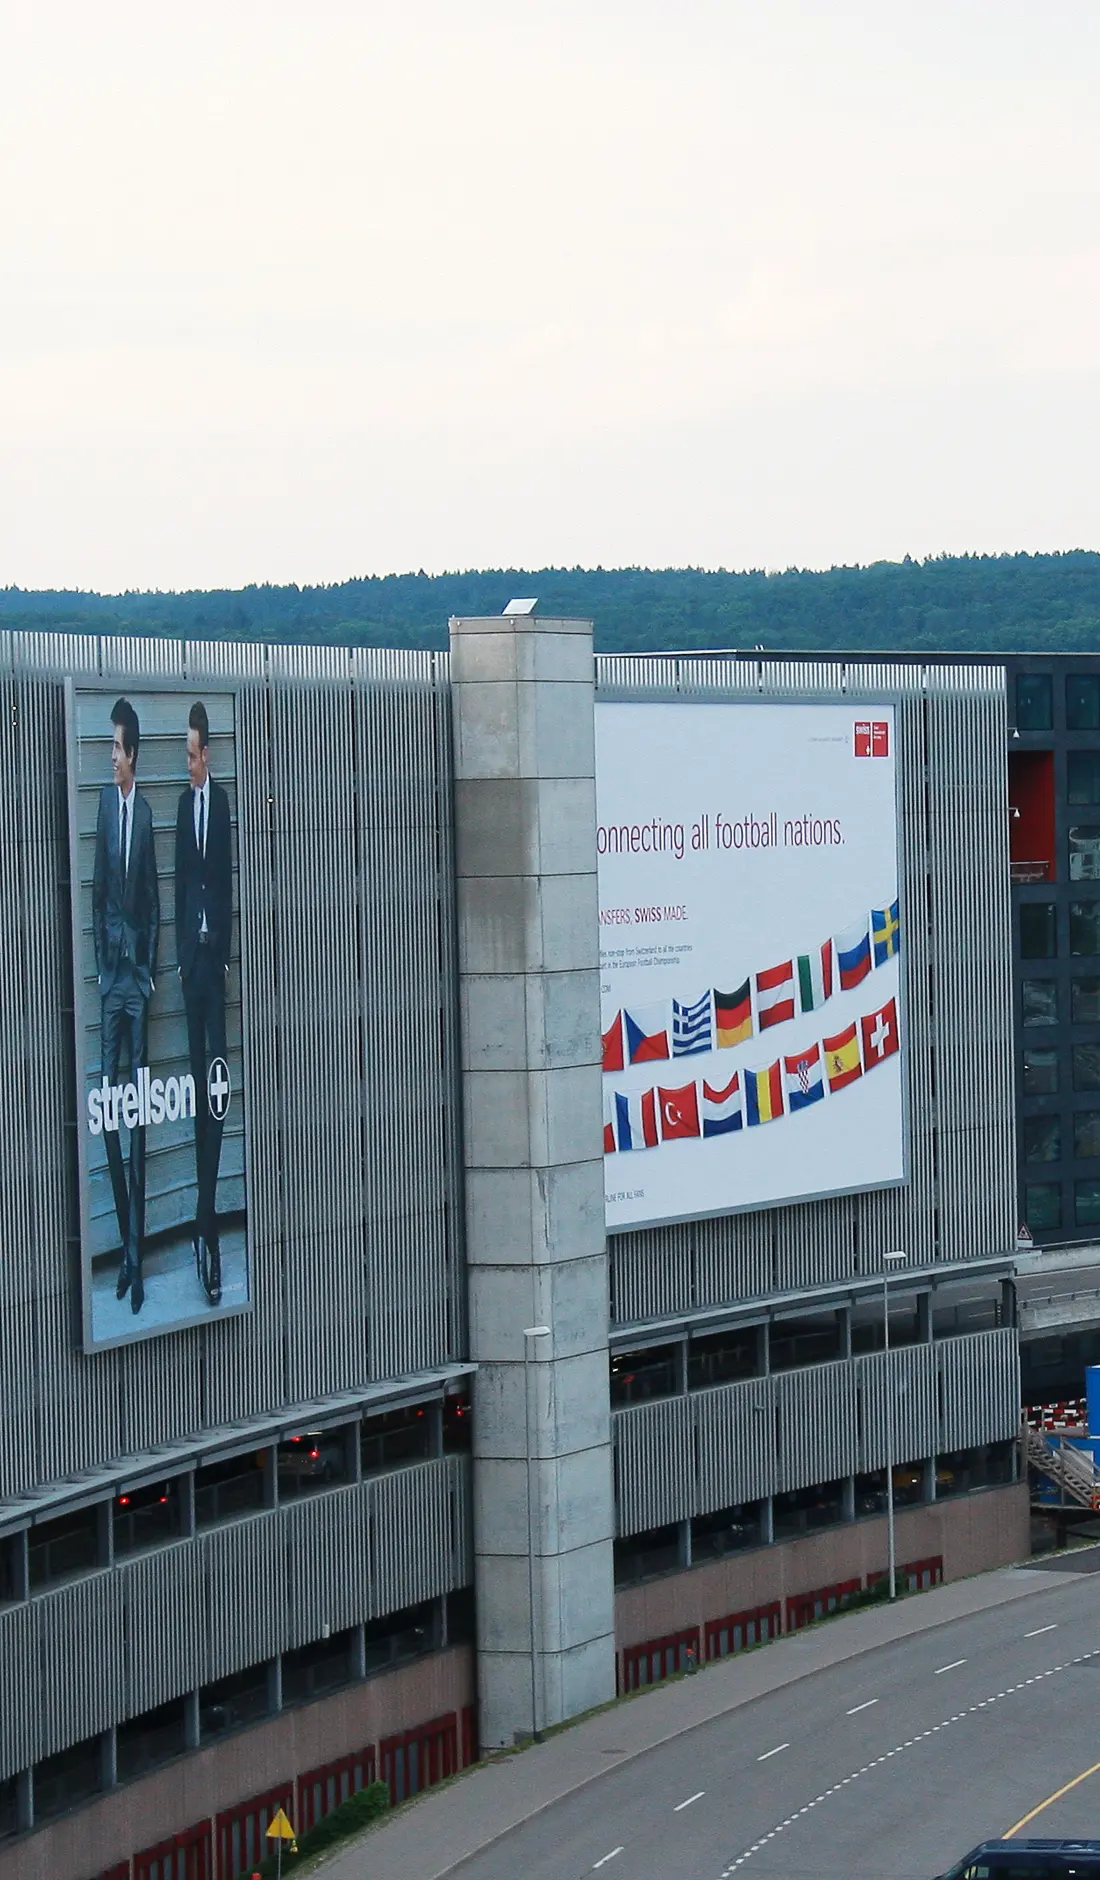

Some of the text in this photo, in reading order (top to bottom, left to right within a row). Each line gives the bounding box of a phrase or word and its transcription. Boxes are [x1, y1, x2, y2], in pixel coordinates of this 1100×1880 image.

[597, 812, 846, 860] onnecting all football nations.
[599, 908, 633, 926] NSFERS,
[634, 906, 661, 923] SWISS
[87, 1066, 196, 1136] strellson
